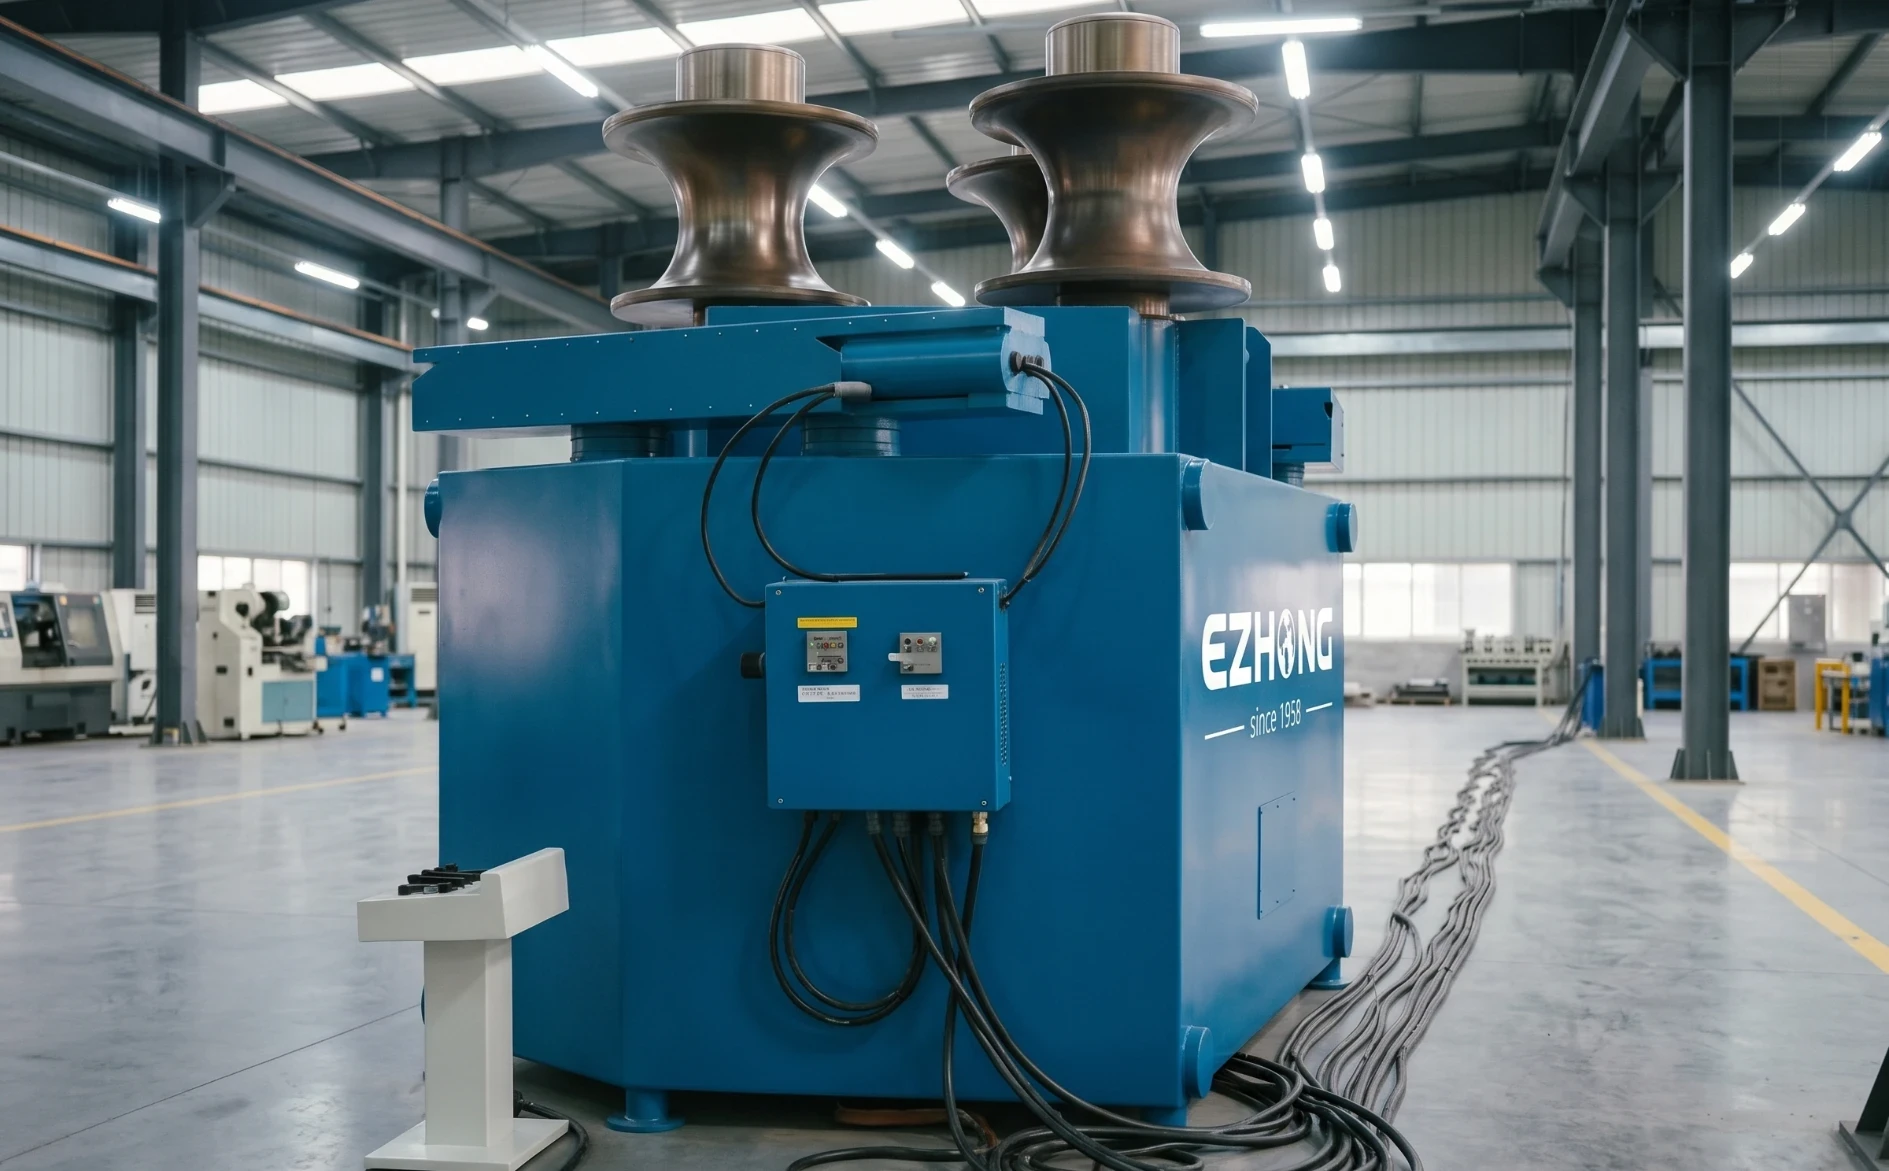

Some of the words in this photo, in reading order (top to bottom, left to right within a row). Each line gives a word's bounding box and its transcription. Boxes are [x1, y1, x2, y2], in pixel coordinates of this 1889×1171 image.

[1202, 607, 1333, 691] EZHONG
[1250, 706, 1277, 739] since
[1280, 698, 1302, 729] 1958
